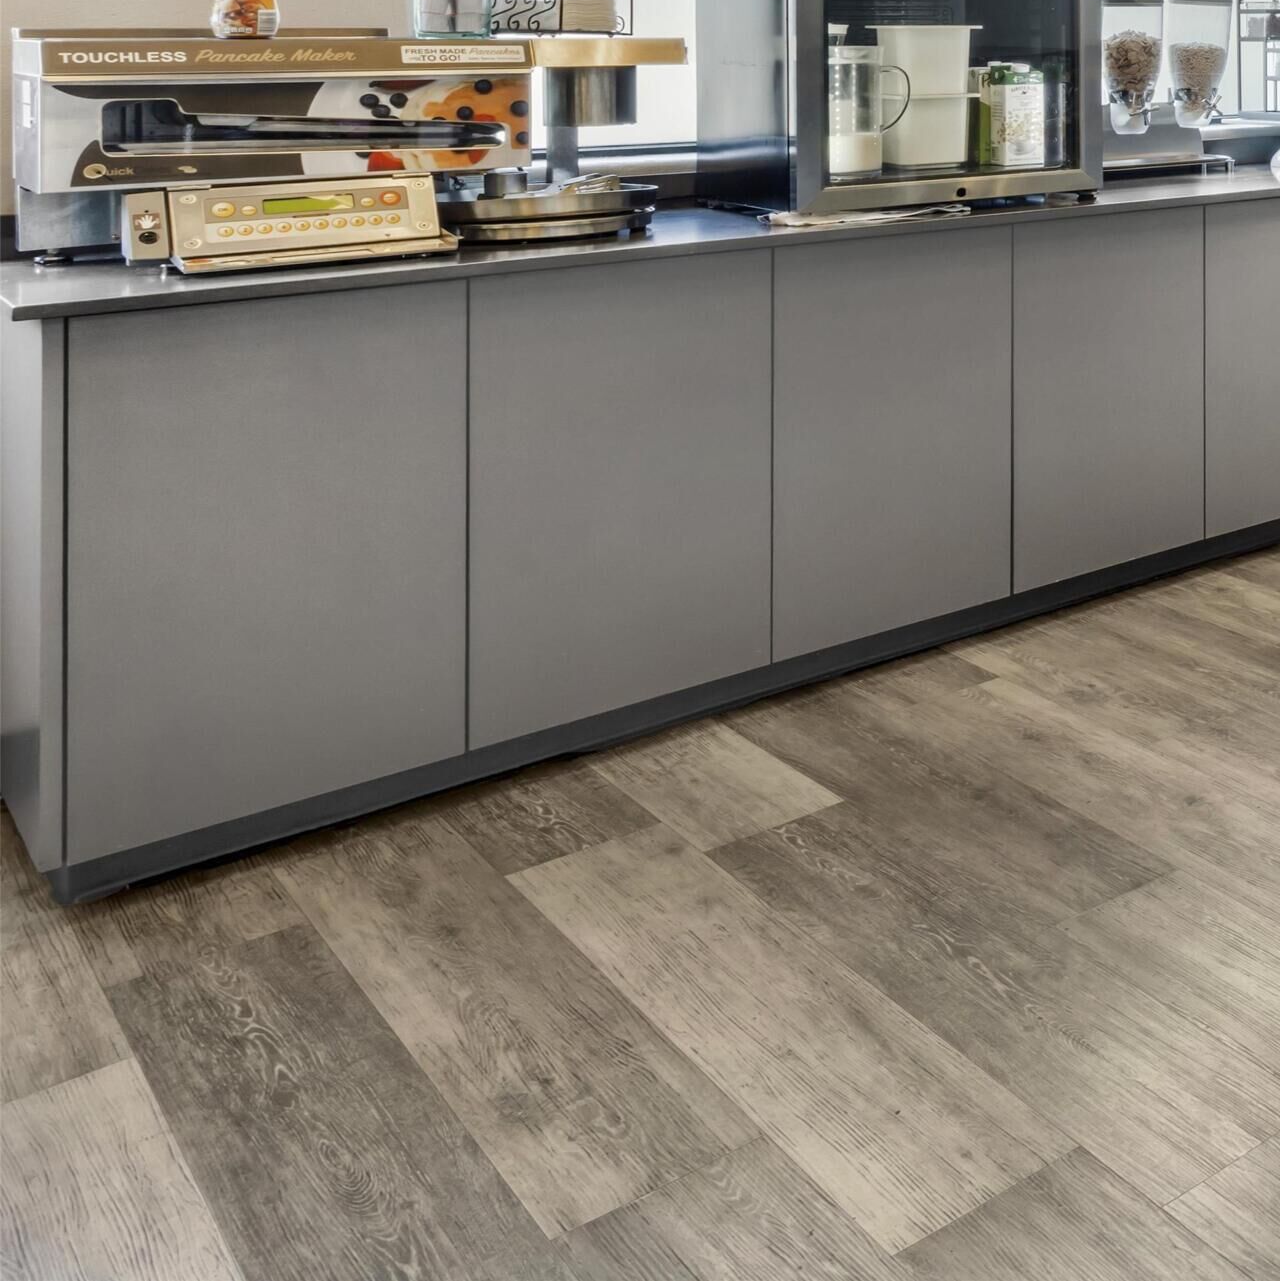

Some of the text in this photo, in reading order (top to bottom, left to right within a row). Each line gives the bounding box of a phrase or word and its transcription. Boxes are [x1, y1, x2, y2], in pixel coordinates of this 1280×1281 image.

[58, 48, 356, 64] TOUCHLESS Pancake Maker
[439, 54, 461, 62] GO!
